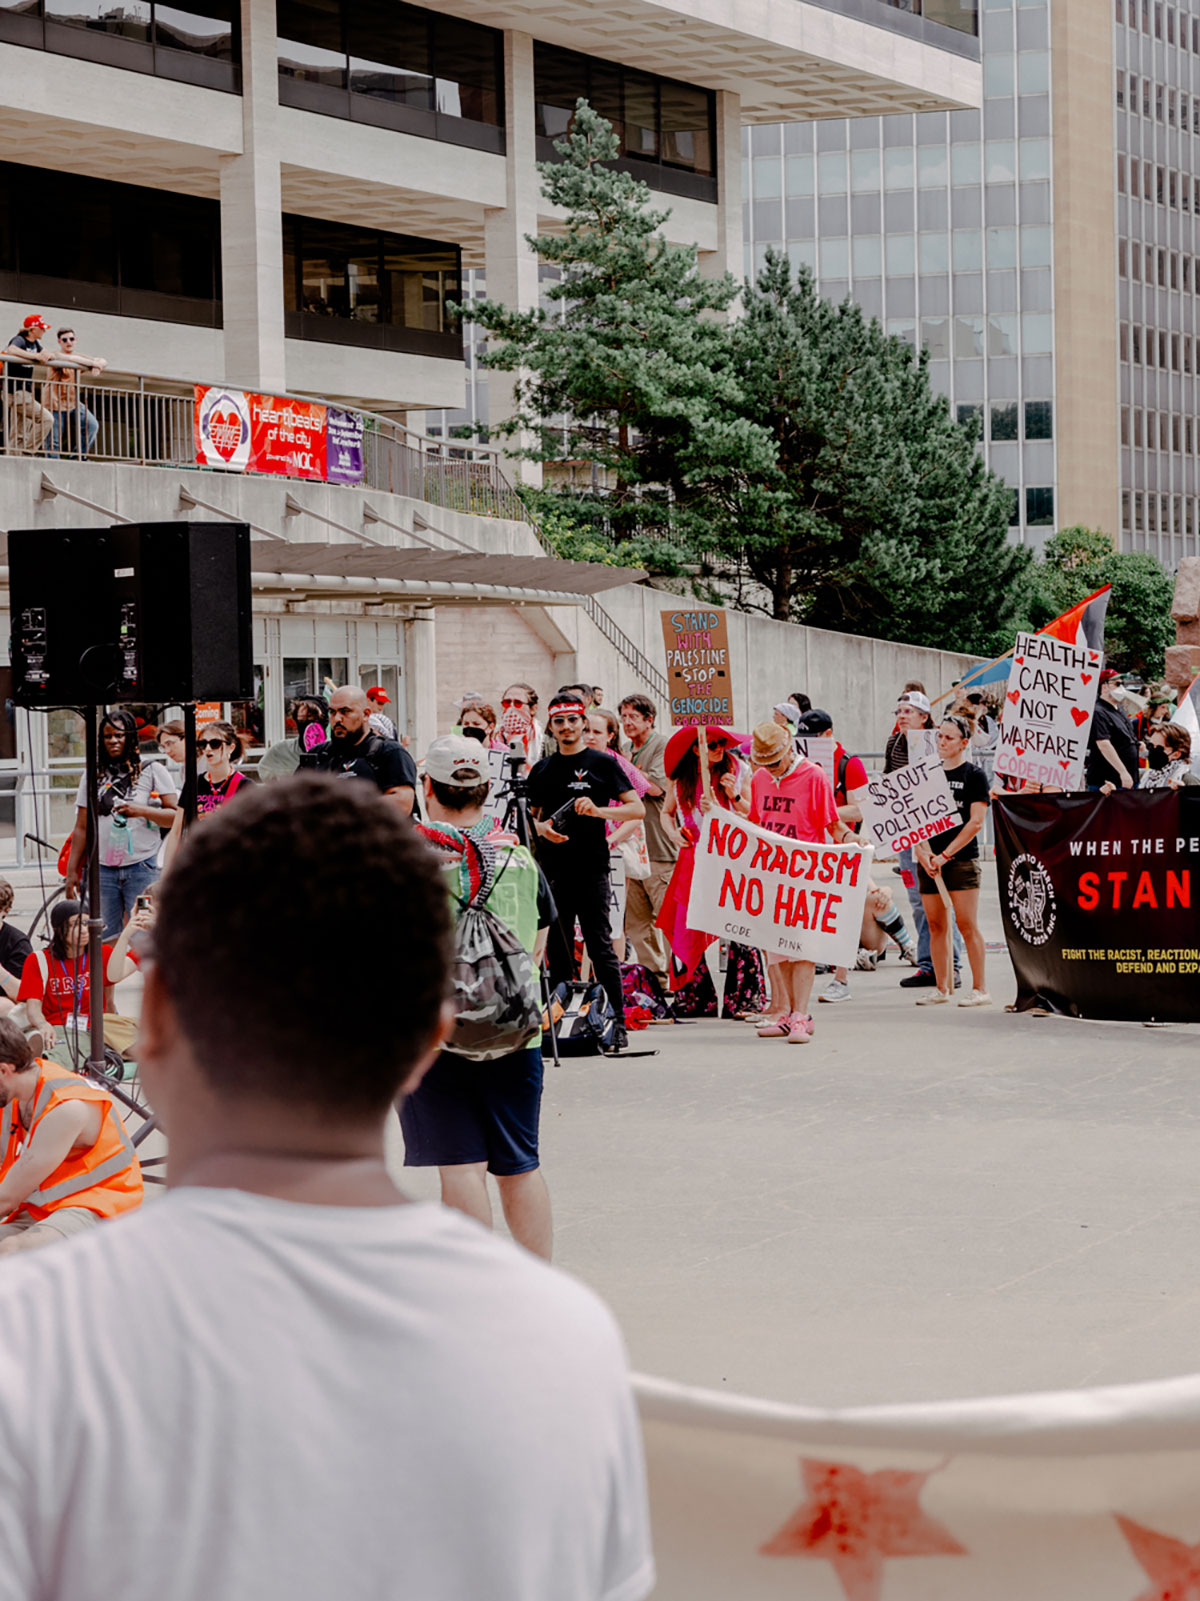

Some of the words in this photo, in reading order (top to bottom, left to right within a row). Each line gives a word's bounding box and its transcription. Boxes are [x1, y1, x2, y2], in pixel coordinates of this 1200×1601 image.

[267, 427, 278, 440] of
[279, 428, 295, 443] the
[296, 431, 311, 449] city
[671, 612, 719, 633] STAND
[677, 632, 712, 649] WITH
[666, 648, 726, 668] PALESTINE
[682, 667, 716, 682] STOP
[1019, 666, 1078, 701] CARE
[688, 683, 712, 696] THE
[671, 696, 729, 714] GENOCIDE
[1020, 698, 1058, 722] NOT
[674, 714, 733, 726] CODEPINK
[1000, 723, 1079, 761] WARFARE
[897, 762, 928, 791] OUT
[996, 752, 1076, 789] CODEPINK
[763, 795, 795, 814] LET
[891, 793, 914, 814] OF
[873, 795, 949, 842] POLITICS
[891, 816, 956, 852] CODEPINK
[707, 818, 748, 860] NO
[750, 837, 862, 887] RACISM
[1069, 840, 1122, 856] WHEN
[1131, 838, 1165, 854] THE
[1007, 853, 1026, 897] COALITION
[1026, 853, 1036, 865] TO
[1036, 861, 1055, 899] MARCH
[718, 868, 764, 917] NO
[774, 883, 843, 934] HATE
[724, 922, 752, 938] CODE
[778, 937, 803, 952] PINK
[1011, 912, 1021, 929] ON
[1020, 927, 1032, 943] THE
[1046, 912, 1057, 935] RNC
[1062, 949, 1086, 960] FIGHT
[1088, 949, 1106, 960] THE
[1107, 949, 1146, 962] RACIST,
[1116, 962, 1154, 974] DEFEND
[1155, 962, 1177, 974] AND
